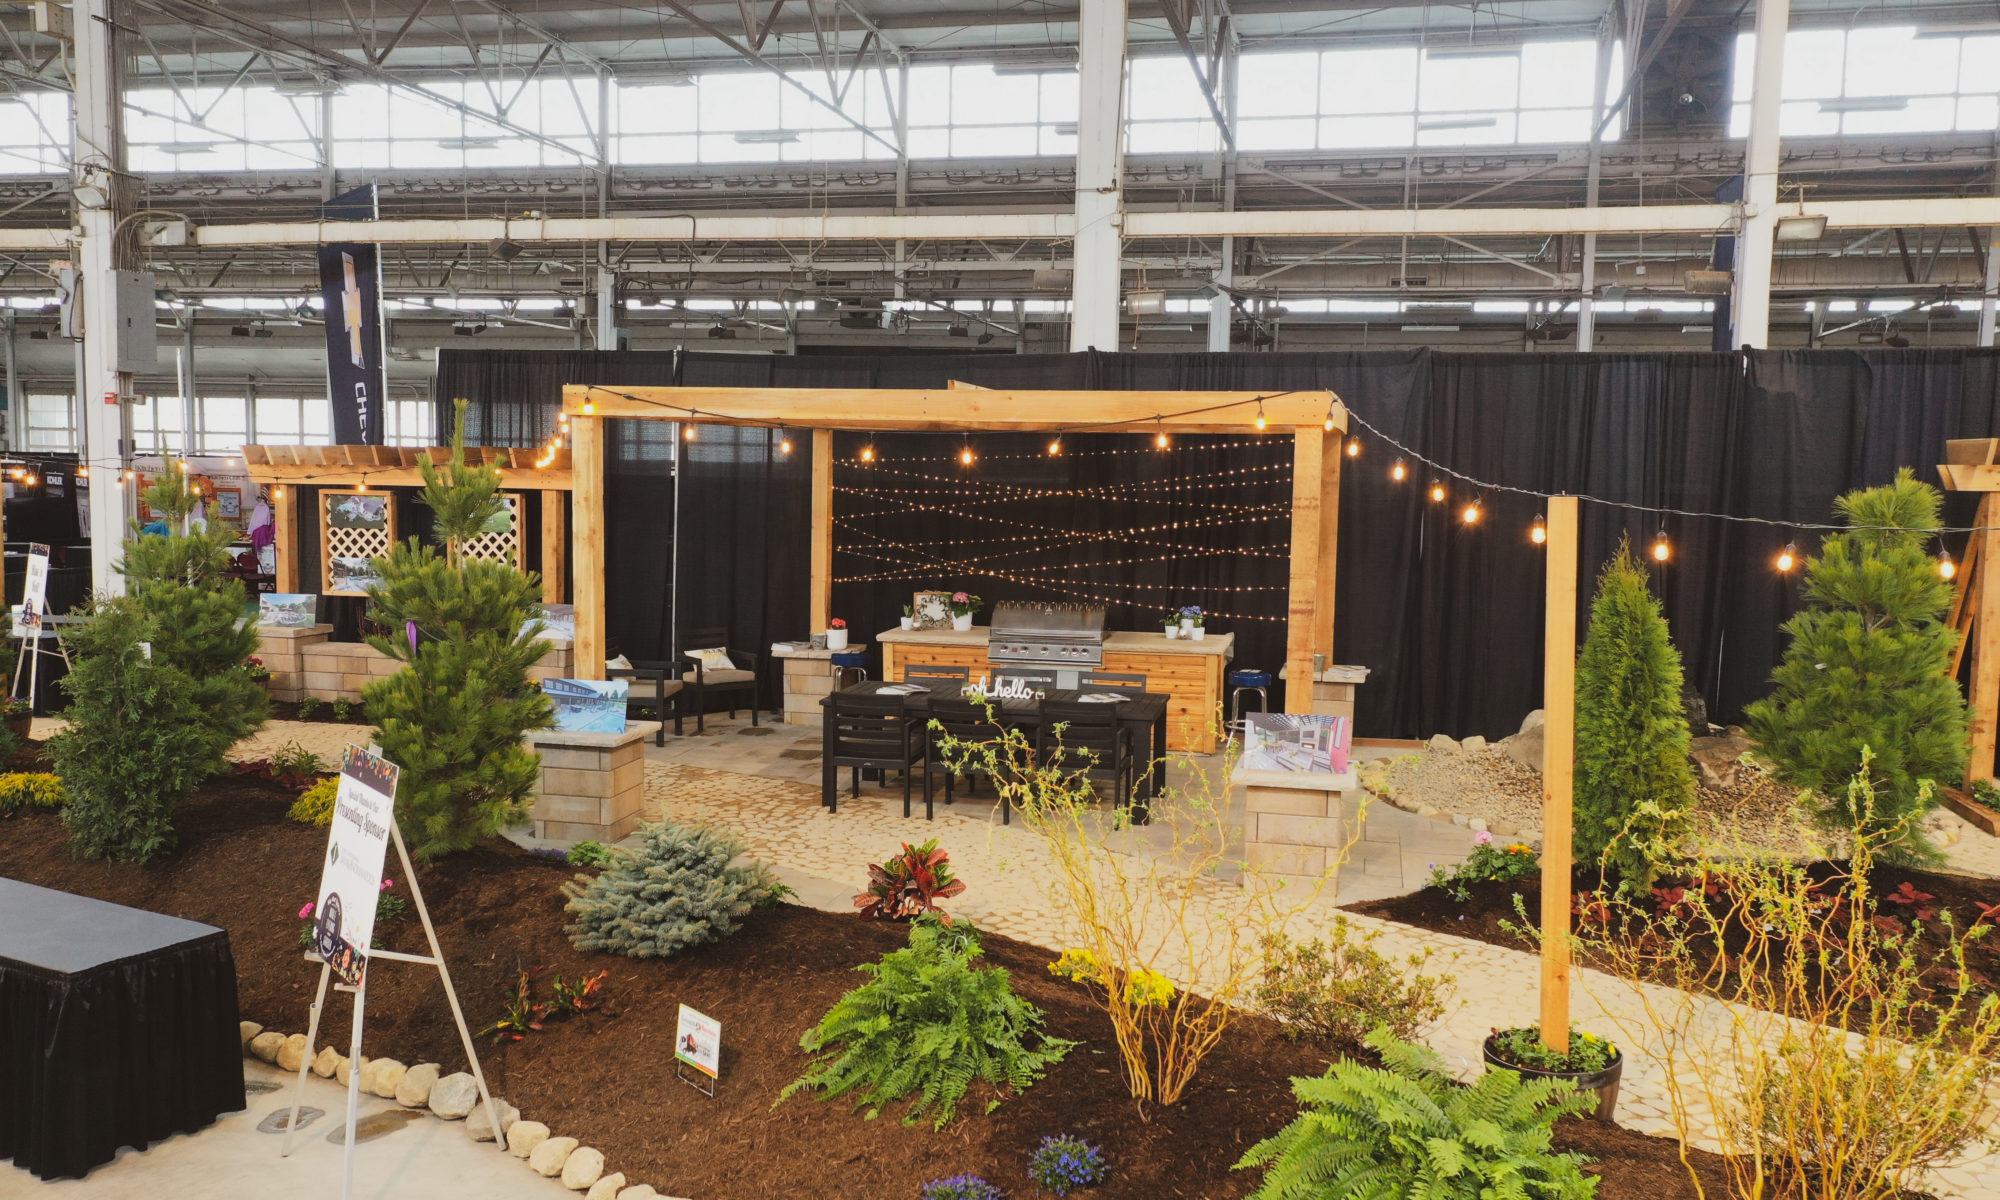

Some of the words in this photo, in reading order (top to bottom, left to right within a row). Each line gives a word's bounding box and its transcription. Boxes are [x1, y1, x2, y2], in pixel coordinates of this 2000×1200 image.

[970, 676, 991, 697] oh
[991, 676, 1035, 700] hello
[336, 797, 364, 833] Presenting
[363, 812, 387, 841] Sponsor
